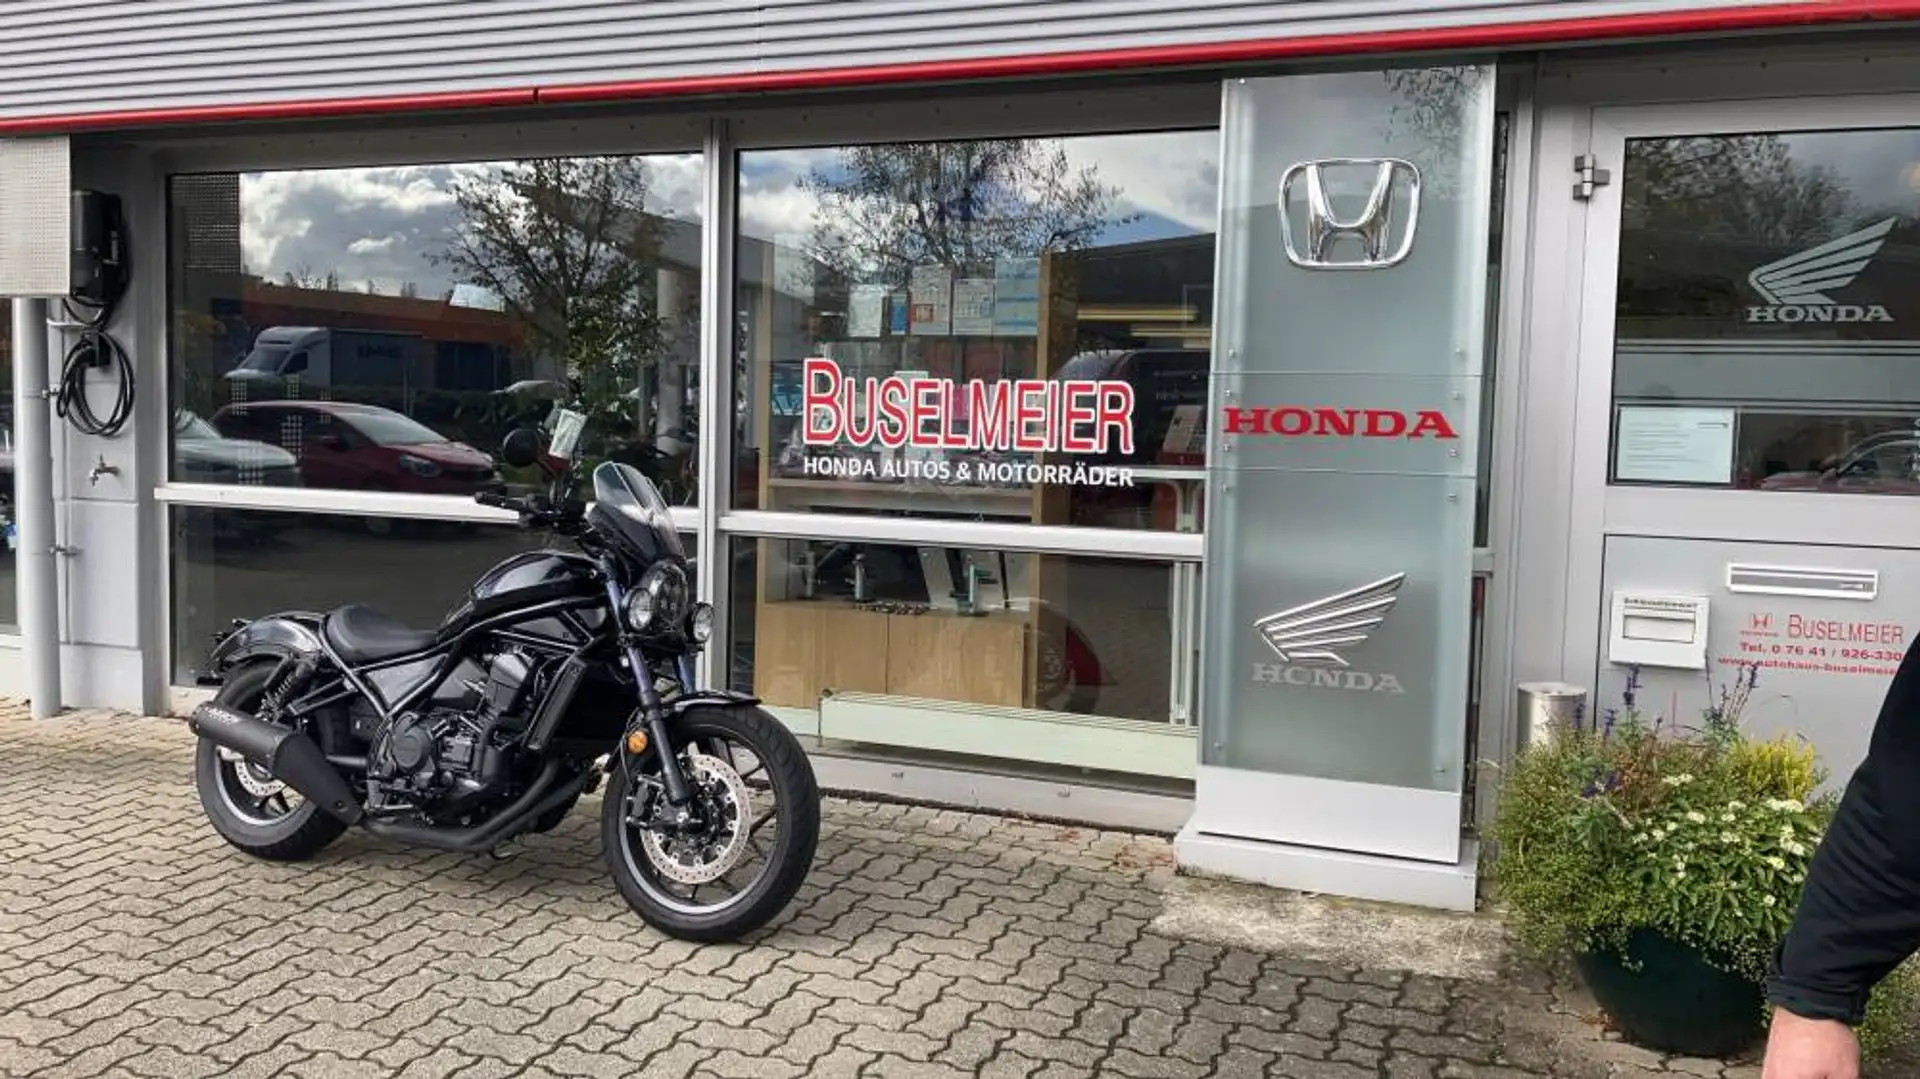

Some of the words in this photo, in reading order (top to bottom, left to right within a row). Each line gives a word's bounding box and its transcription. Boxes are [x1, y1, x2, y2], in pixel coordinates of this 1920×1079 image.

[1747, 304, 1895, 323] HONDA
[802, 357, 1136, 455] BUSELMEIER
[1223, 407, 1459, 439] HONDA
[803, 456, 876, 476] HONDA
[881, 459, 951, 481] AUTOS
[955, 461, 972, 480] &
[978, 461, 1134, 487] MOTORRÄDER
[1788, 613, 1904, 644] BUSELMEIER
[1740, 642, 1766, 654] Tel.
[1251, 662, 1407, 694] HONDA
